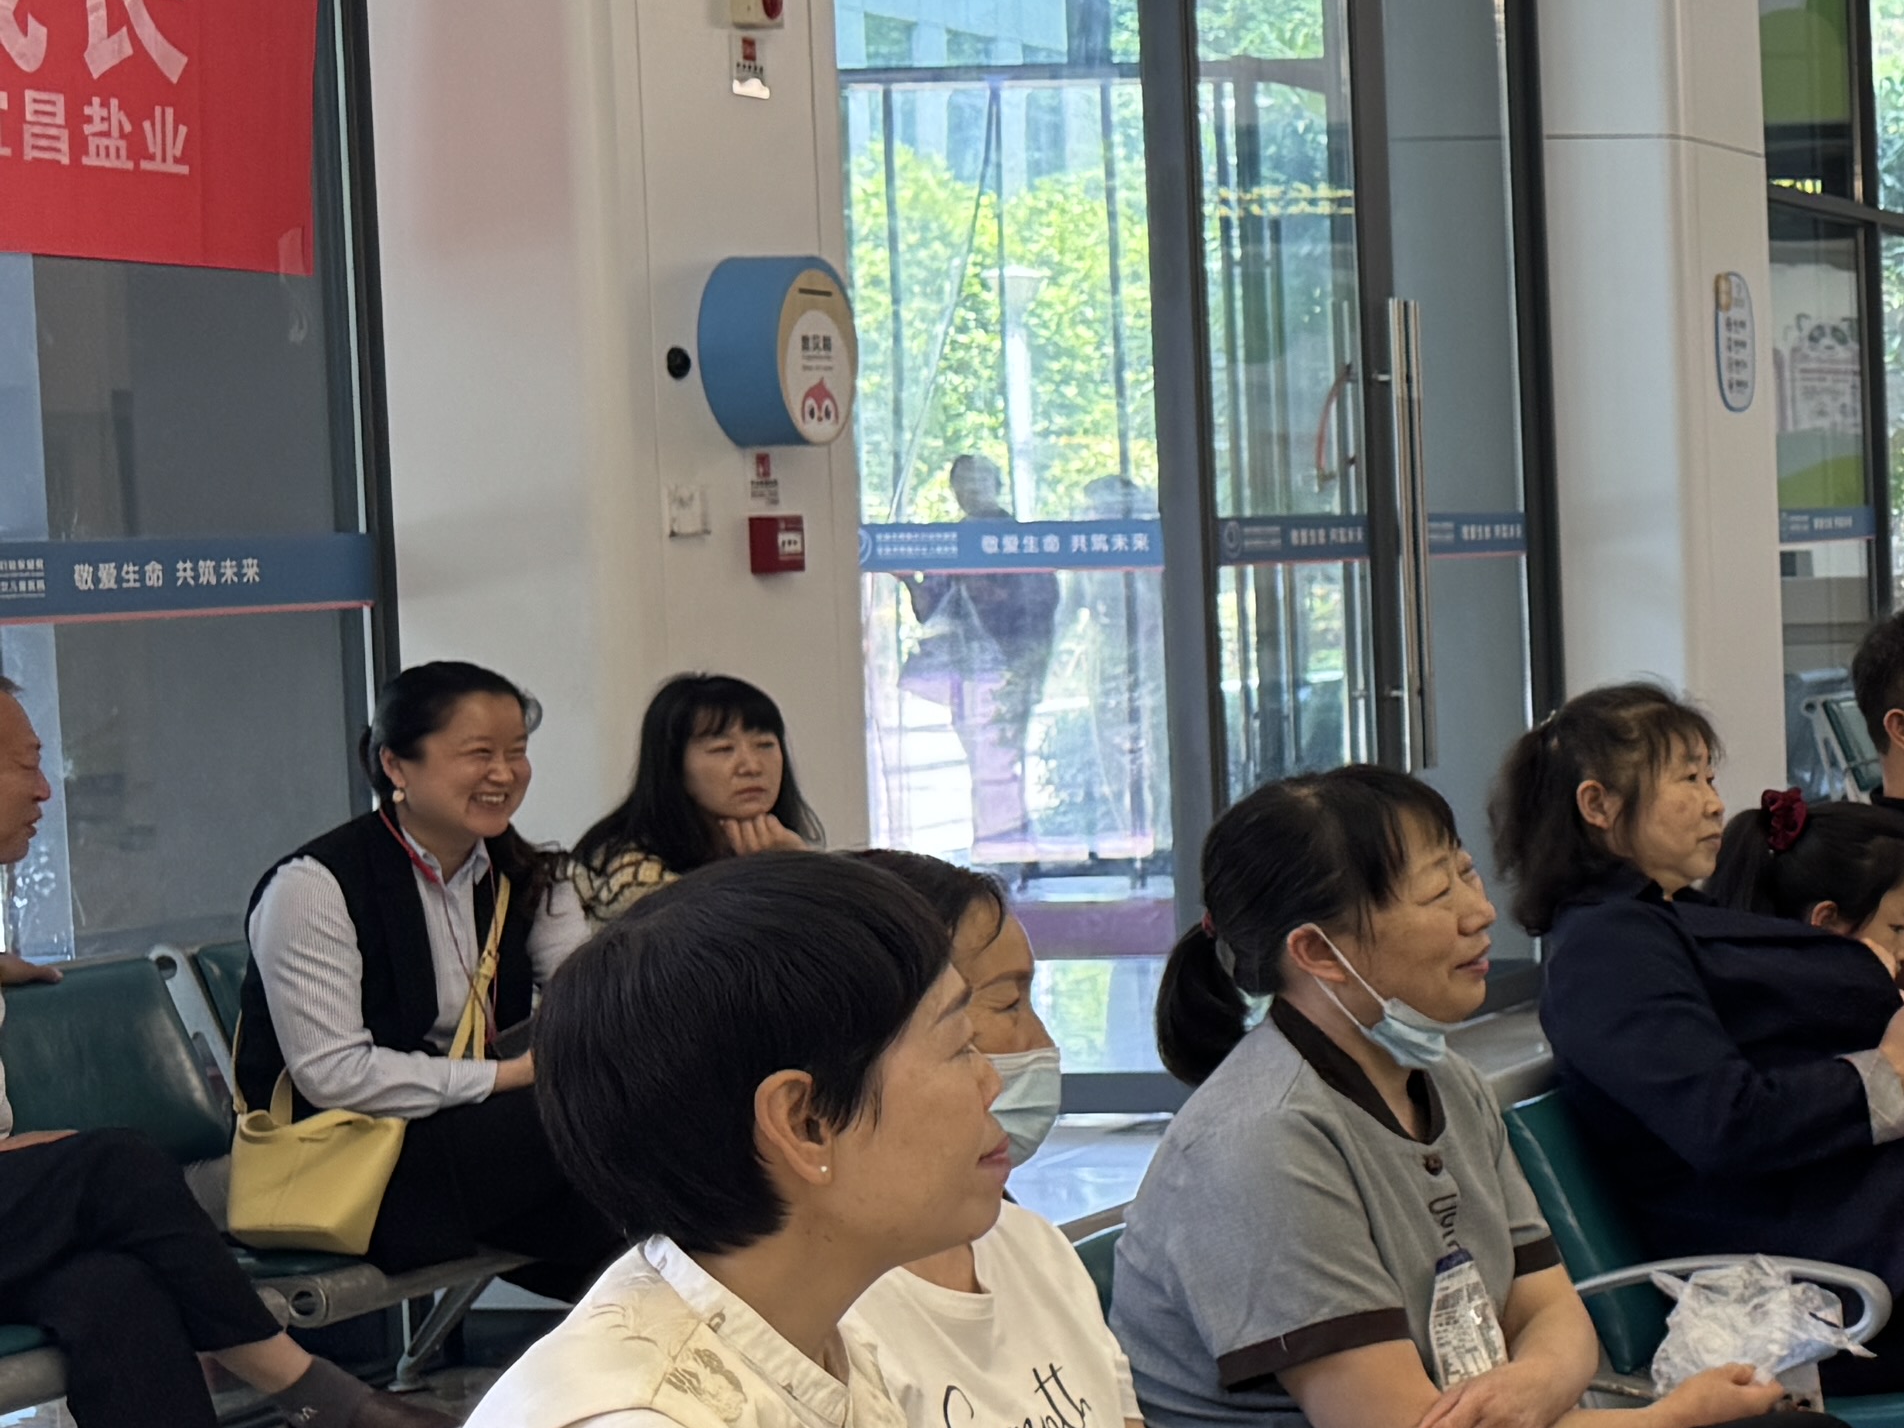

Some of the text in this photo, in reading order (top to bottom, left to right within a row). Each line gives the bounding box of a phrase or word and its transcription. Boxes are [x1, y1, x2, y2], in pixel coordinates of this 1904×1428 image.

[0, 89, 190, 175] 昌盐业
[74, 560, 163, 591] 敬爱生命
[176, 558, 260, 588] 共筑未来
